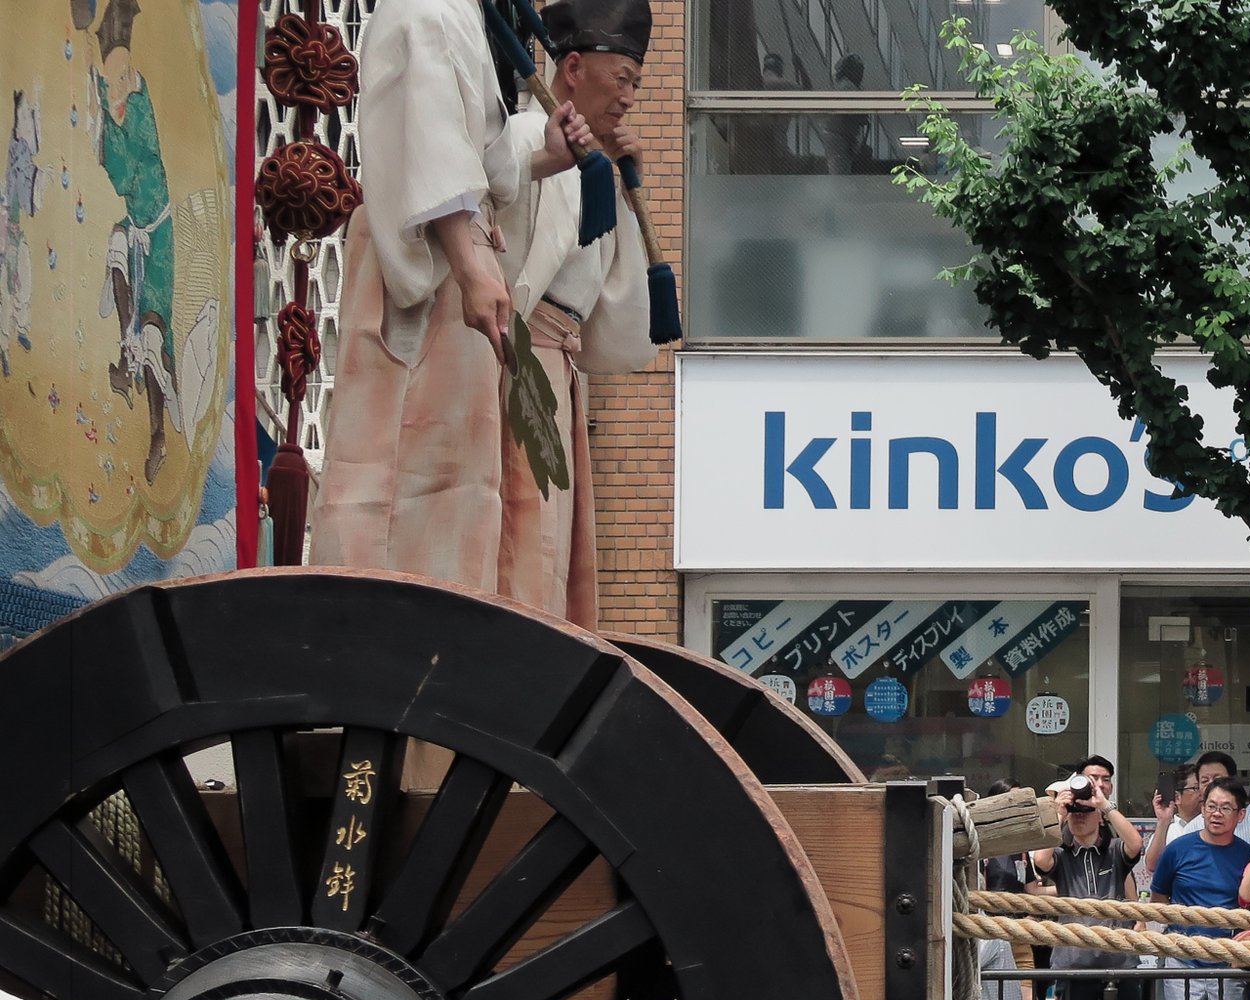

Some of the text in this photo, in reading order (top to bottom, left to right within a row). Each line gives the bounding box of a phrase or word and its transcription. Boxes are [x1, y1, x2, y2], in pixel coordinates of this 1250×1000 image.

[732, 617, 791, 669] コピー
[784, 610, 855, 670] プリント
[841, 610, 909, 670] ポスター
[893, 605, 963, 671] ディスプレイ
[1003, 607, 1076, 671] 資料作成
